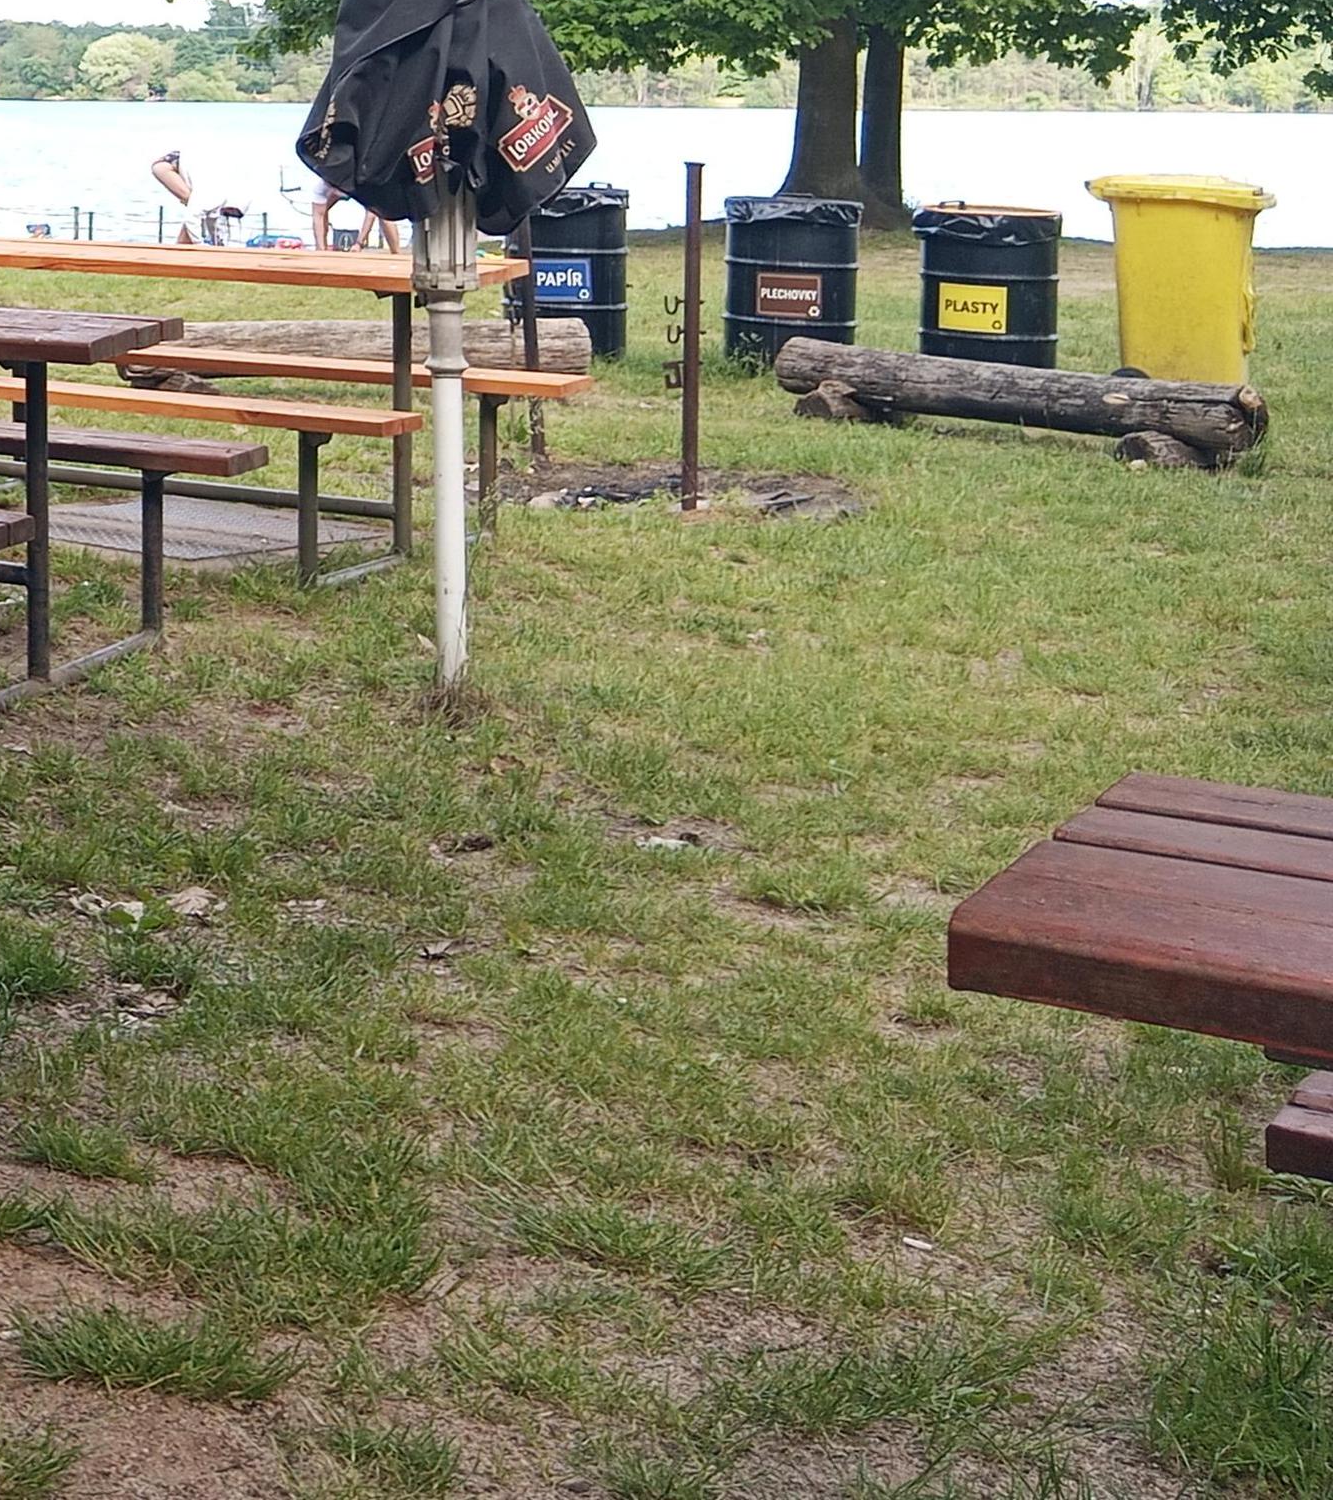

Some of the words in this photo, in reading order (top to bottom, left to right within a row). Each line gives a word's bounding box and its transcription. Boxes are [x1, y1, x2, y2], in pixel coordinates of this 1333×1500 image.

[536, 268, 583, 287] PAPÍR
[760, 287, 817, 301] PLECHOVKY
[945, 298, 999, 315] PLASTY
